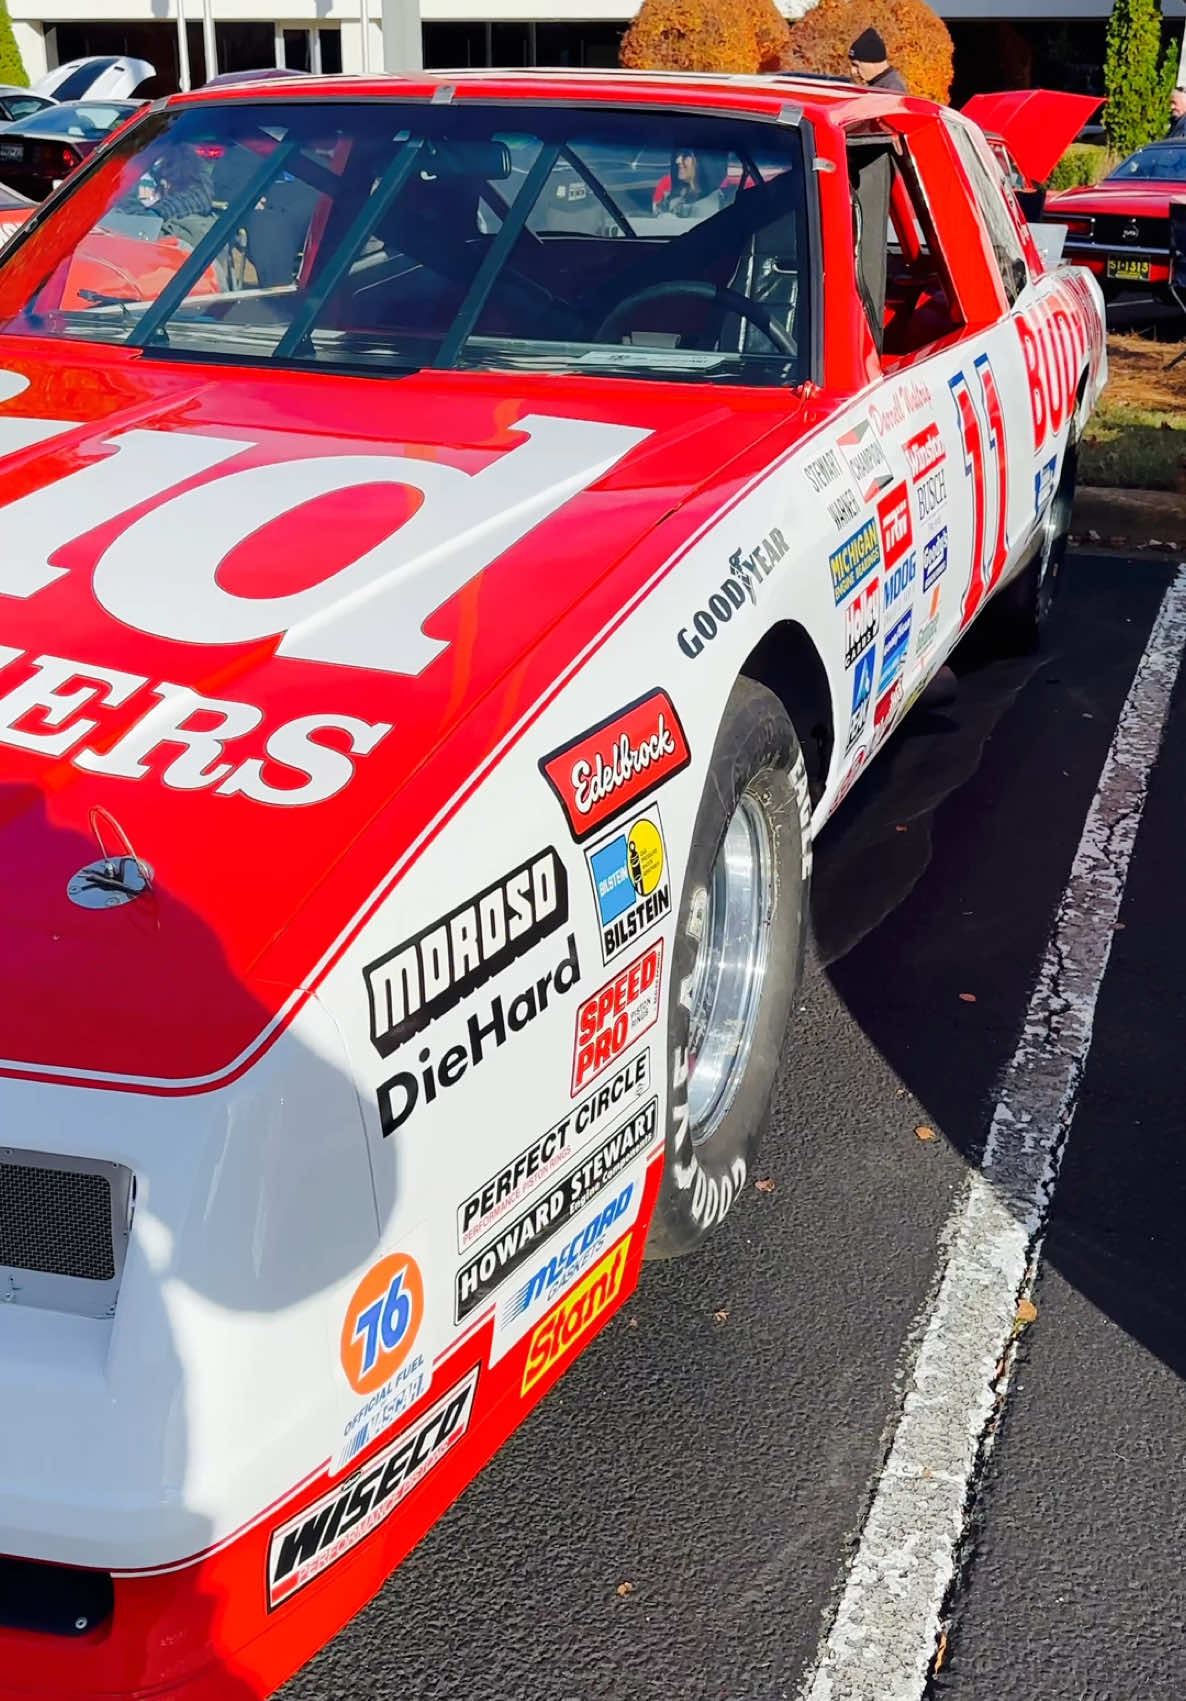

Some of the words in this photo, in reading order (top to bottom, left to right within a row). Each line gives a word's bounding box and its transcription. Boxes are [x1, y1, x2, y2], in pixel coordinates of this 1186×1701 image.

[804, 448, 842, 493] STEWART
[827, 488, 861, 531] WARNER
[917, 471, 948, 520] BUSCH
[946, 353, 1010, 622] 11
[677, 527, 790, 659] GOODYEAR
[829, 521, 878, 587] MICHIGAN
[882, 550, 917, 610] MOOG
[0, 648, 395, 808] ERS
[571, 712, 676, 815] Edelbrock
[599, 864, 629, 898] BILSTEIN
[603, 884, 670, 958] BILSTEIN
[366, 849, 562, 1046] MOROSO
[579, 950, 657, 1046] SPEED
[376, 933, 581, 1139] DieHard
[575, 1012, 629, 1088] PRO
[462, 1119, 570, 1234] PERFECT
[575, 1054, 647, 1134] CIRCLE
[463, 1188, 521, 1244] PERFORMANCE
[522, 1164, 549, 1193] PISTON
[549, 1144, 572, 1168] RINGS
[461, 1189, 564, 1302] HOWARD
[570, 1103, 656, 1201] STEWART
[522, 1242, 628, 1394] Stant
[546, 1233, 608, 1302] GASKETS
[354, 1267, 412, 1379] 76
[344, 1381, 393, 1436] OFFICIAL
[395, 1354, 424, 1387] FUEL
[272, 1383, 472, 1585] WISECO
